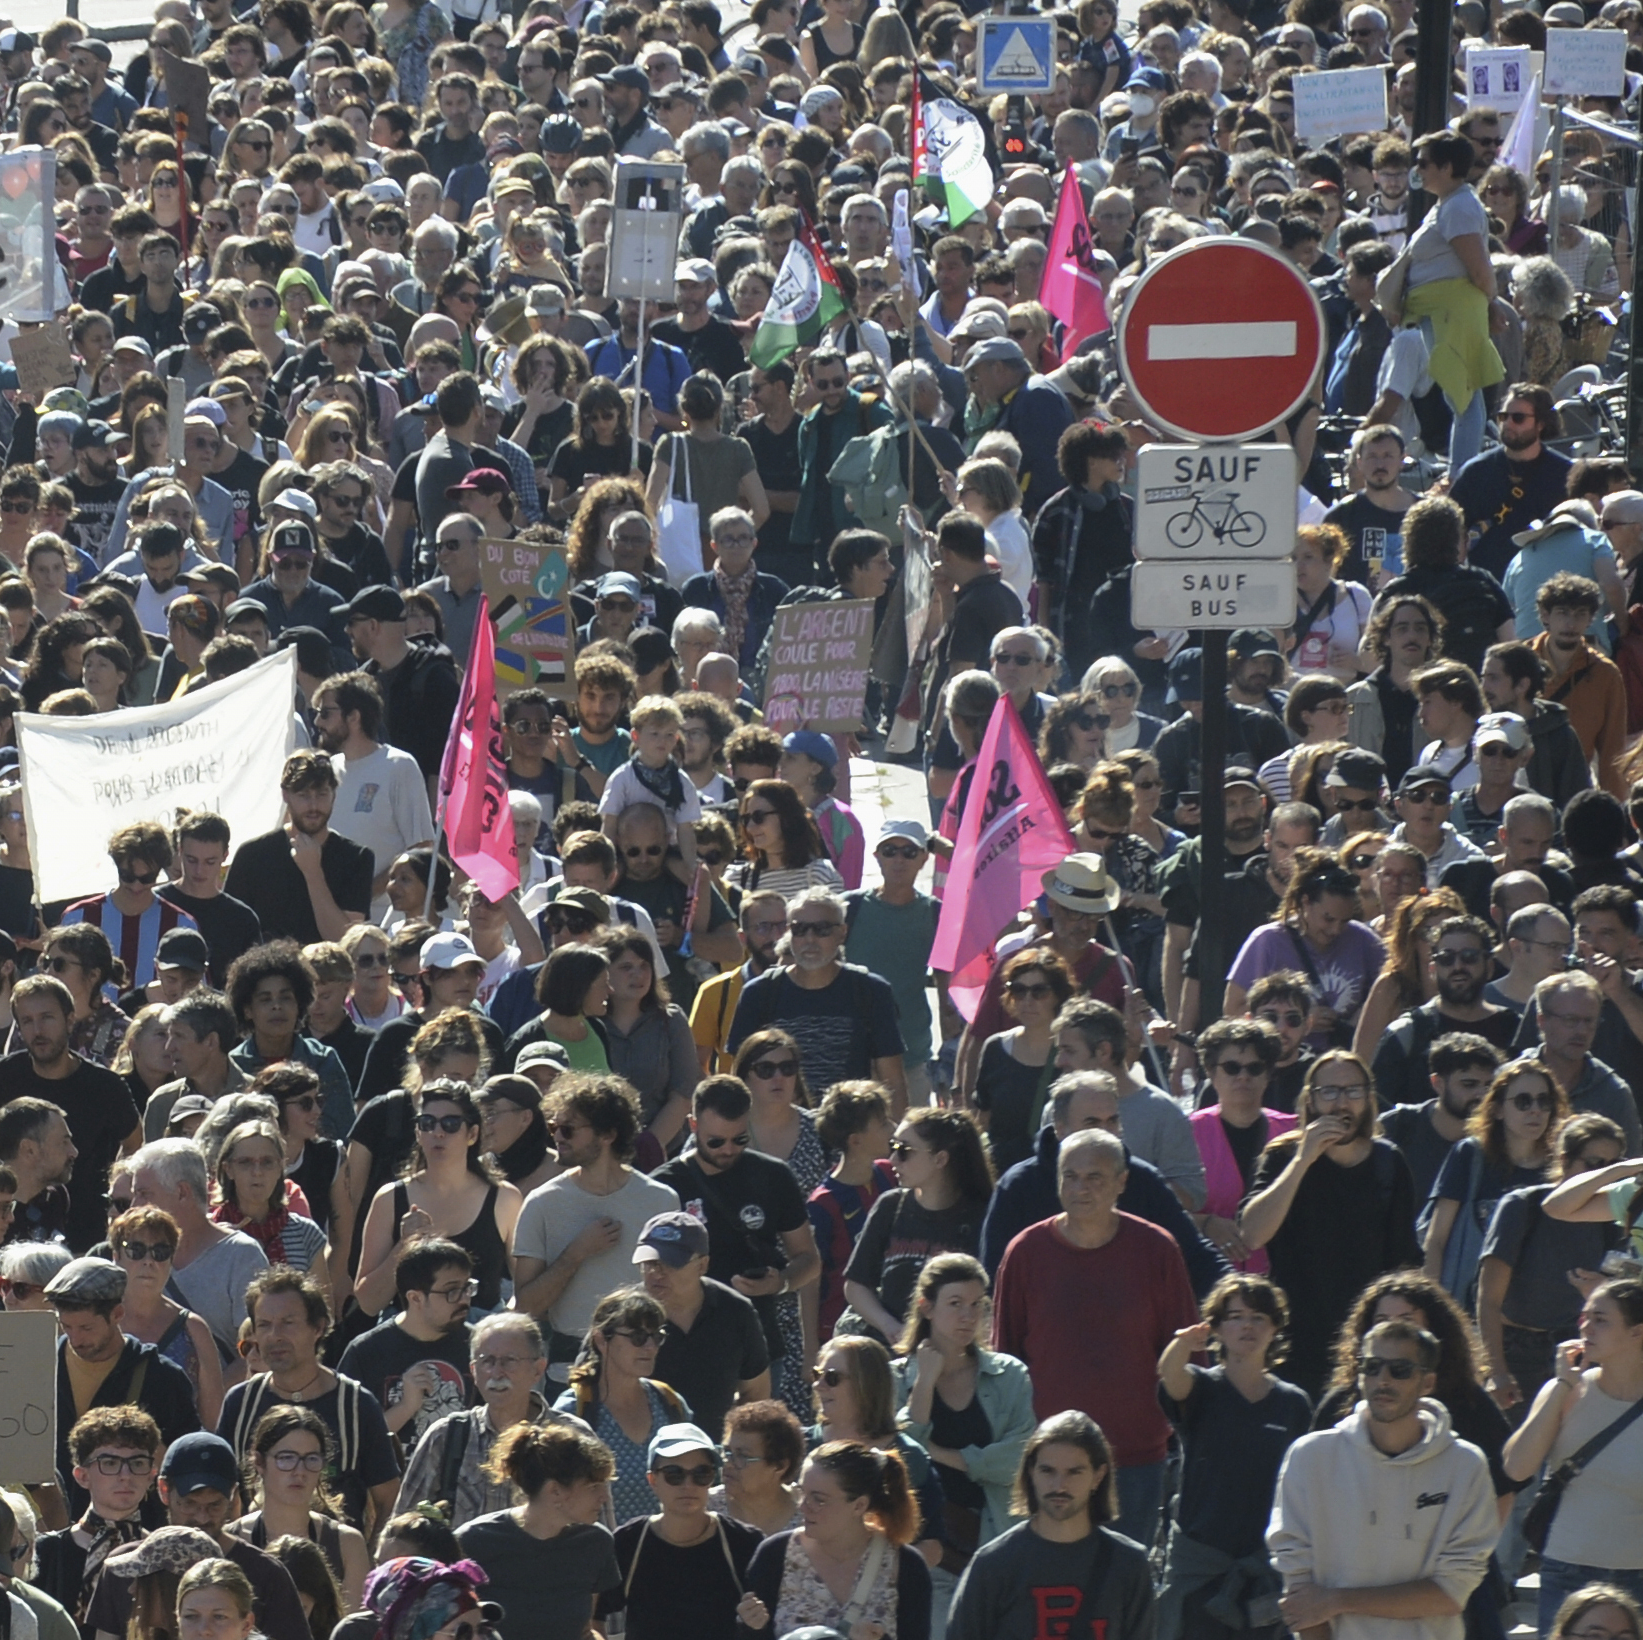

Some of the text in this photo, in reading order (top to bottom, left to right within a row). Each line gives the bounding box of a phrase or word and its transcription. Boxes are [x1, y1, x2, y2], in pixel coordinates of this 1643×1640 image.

[1174, 456, 1261, 483] SAUF
[487, 546, 539, 567] DU BON
[1182, 575, 1247, 591] SAUF
[1191, 600, 1238, 617] BUS
[780, 606, 874, 642] L'ARGENT
[775, 643, 819, 665] COULE
[802, 698, 821, 719] LE
